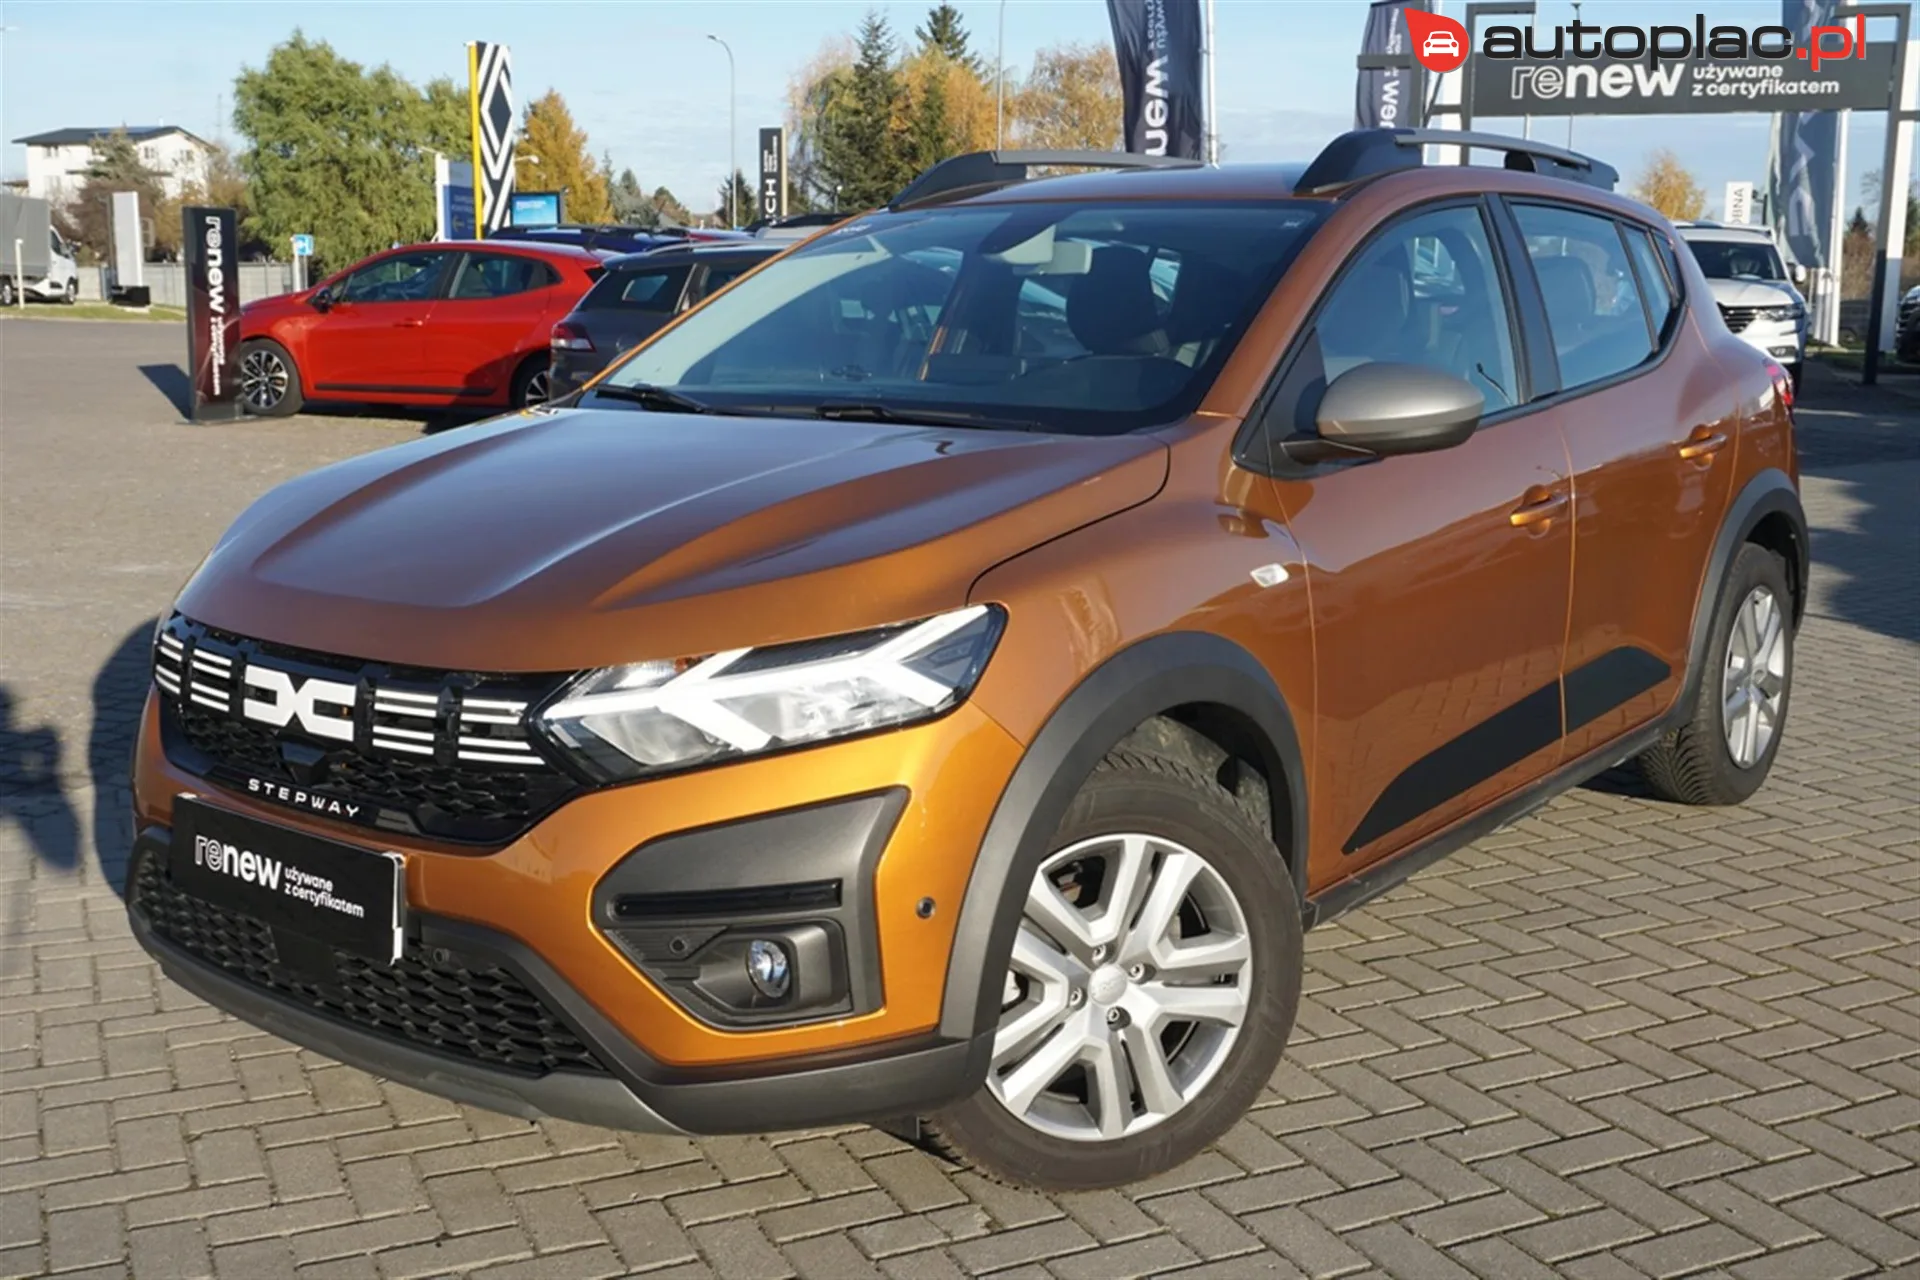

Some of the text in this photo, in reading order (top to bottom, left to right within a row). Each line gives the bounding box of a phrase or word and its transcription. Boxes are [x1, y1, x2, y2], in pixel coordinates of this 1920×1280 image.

[1511, 63, 1686, 100] renew
[1692, 79, 1840, 99] z certyfikatem
[1693, 63, 1783, 82] używane
[205, 215, 225, 314] renew
[248, 778, 360, 817] STEPWAY
[194, 834, 282, 890] renew
[284, 866, 333, 892] używane
[284, 883, 365, 918] z certyfikatem
